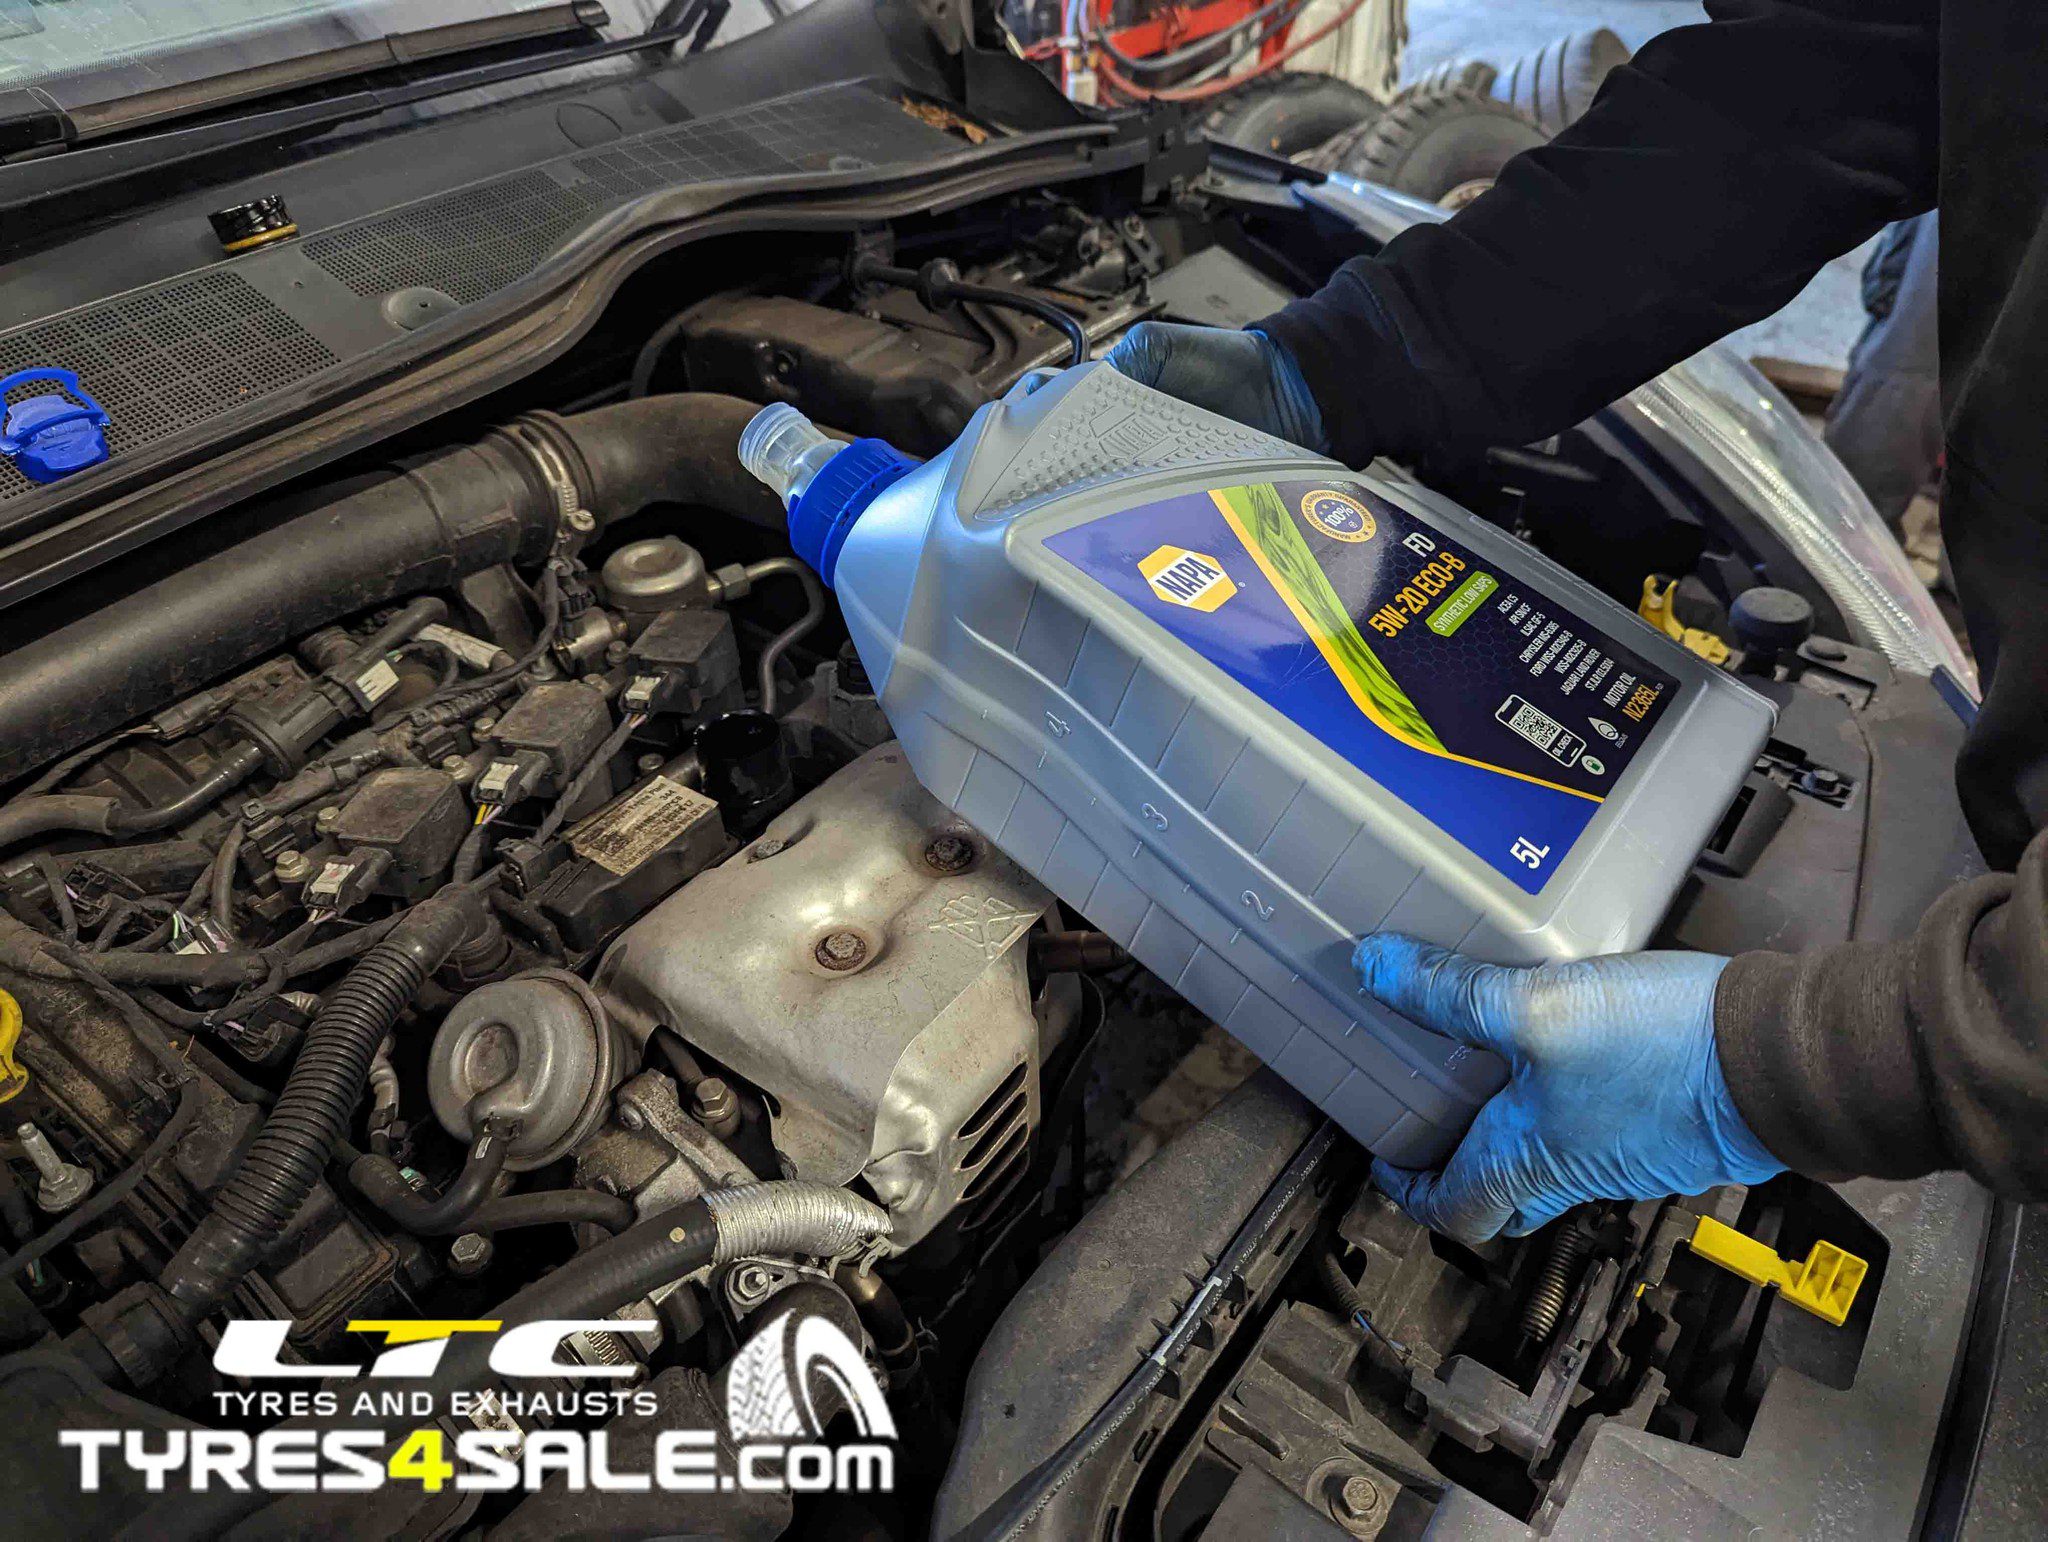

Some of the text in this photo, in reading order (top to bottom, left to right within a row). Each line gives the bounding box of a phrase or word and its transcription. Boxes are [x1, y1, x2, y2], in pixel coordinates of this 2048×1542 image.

[1325, 504, 1354, 527] 100%
[1402, 532, 1436, 558] FD
[1155, 556, 1220, 601] NAPA
[1368, 551, 1466, 637] 5W-20 ECO-B
[1433, 575, 1493, 631] SYNTHETIC LOW SAPS
[1497, 599, 1513, 613] ACEA
[1508, 614, 1520, 625] API
[1520, 611, 1545, 636] ILSAC GF-5
[1519, 638, 1544, 663] CHRYSLER
[1529, 661, 1546, 676] FORD
[1559, 648, 1601, 695] JAGUAR LAND ROVER
[1603, 672, 1636, 708] MOTOR OIL
[1622, 684, 1660, 722] N2365L
[1045, 711, 1072, 737] 4
[1552, 733, 1573, 757] OIL CHECK
[1141, 802, 1169, 831] 3
[1509, 836, 1550, 869] 5L
[1241, 890, 1274, 921] 2
